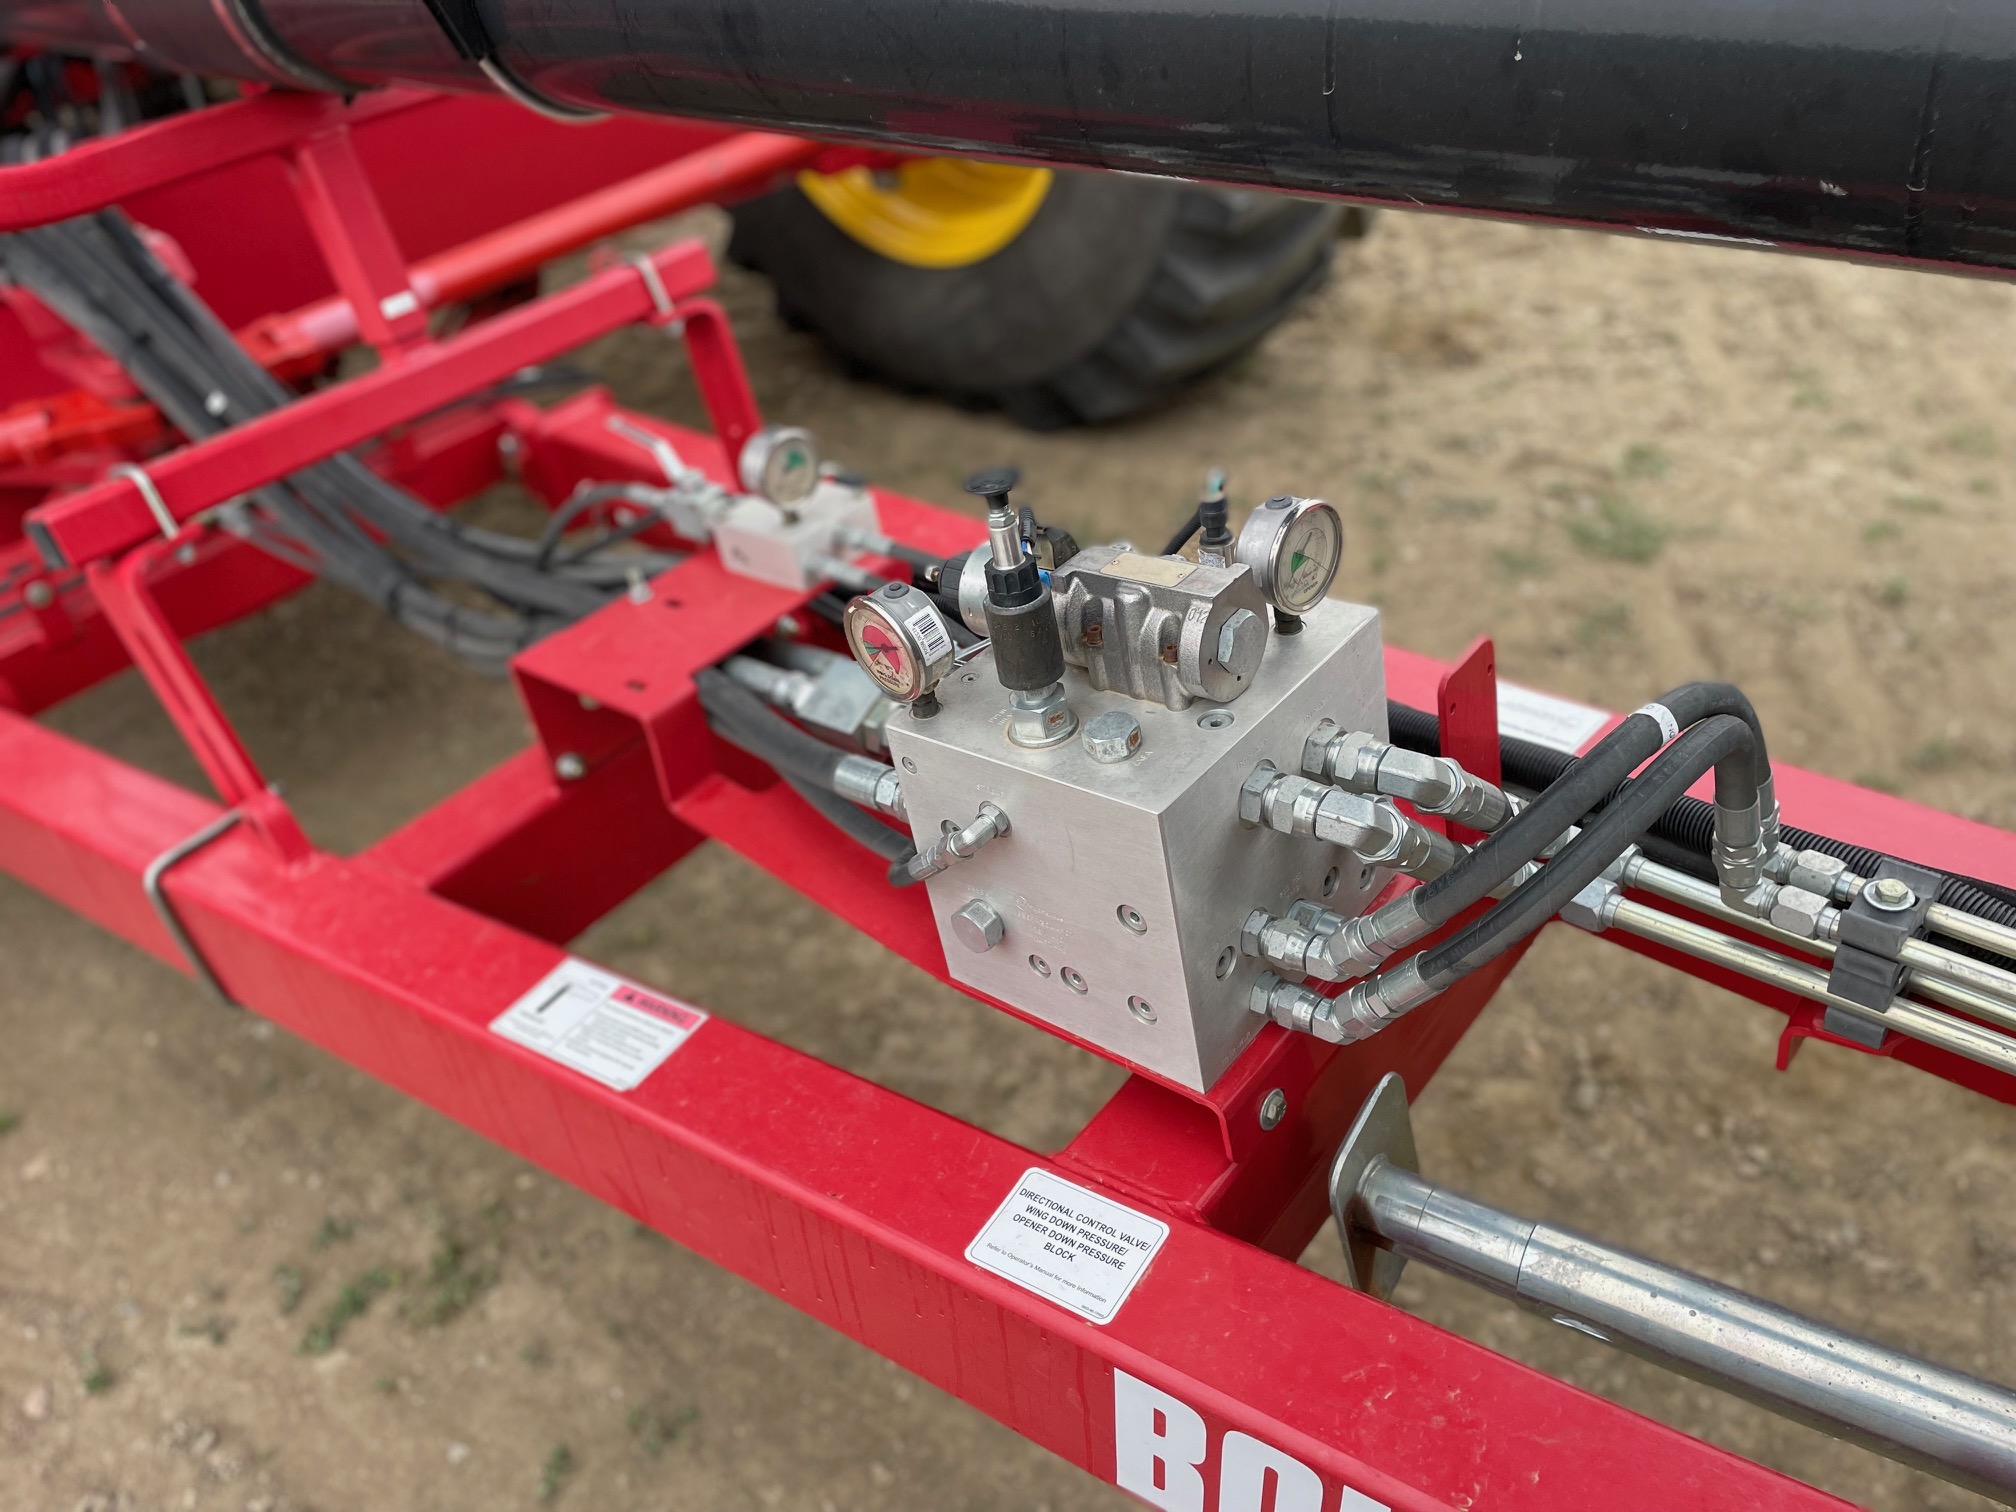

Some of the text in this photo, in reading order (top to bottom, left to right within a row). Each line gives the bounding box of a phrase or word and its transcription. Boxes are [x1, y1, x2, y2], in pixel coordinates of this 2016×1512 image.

[1013, 1214, 1126, 1270] OPENER DOWN PRESSURE
[1020, 1188, 1151, 1251] DIRECTIONAL CONTROL VALVE/
[1026, 1204, 1128, 1256] WING DOWN PRESSURE/
[987, 1242, 1002, 1253] Refer
[1007, 1252, 1034, 1268] Operator's
[1034, 1264, 1055, 1278] Manual
[1054, 1273, 1062, 1281] for
[1062, 1278, 1076, 1289] more
[1044, 1242, 1076, 1262] BLOCK
[1113, 1367, 1392, 1512] BO
